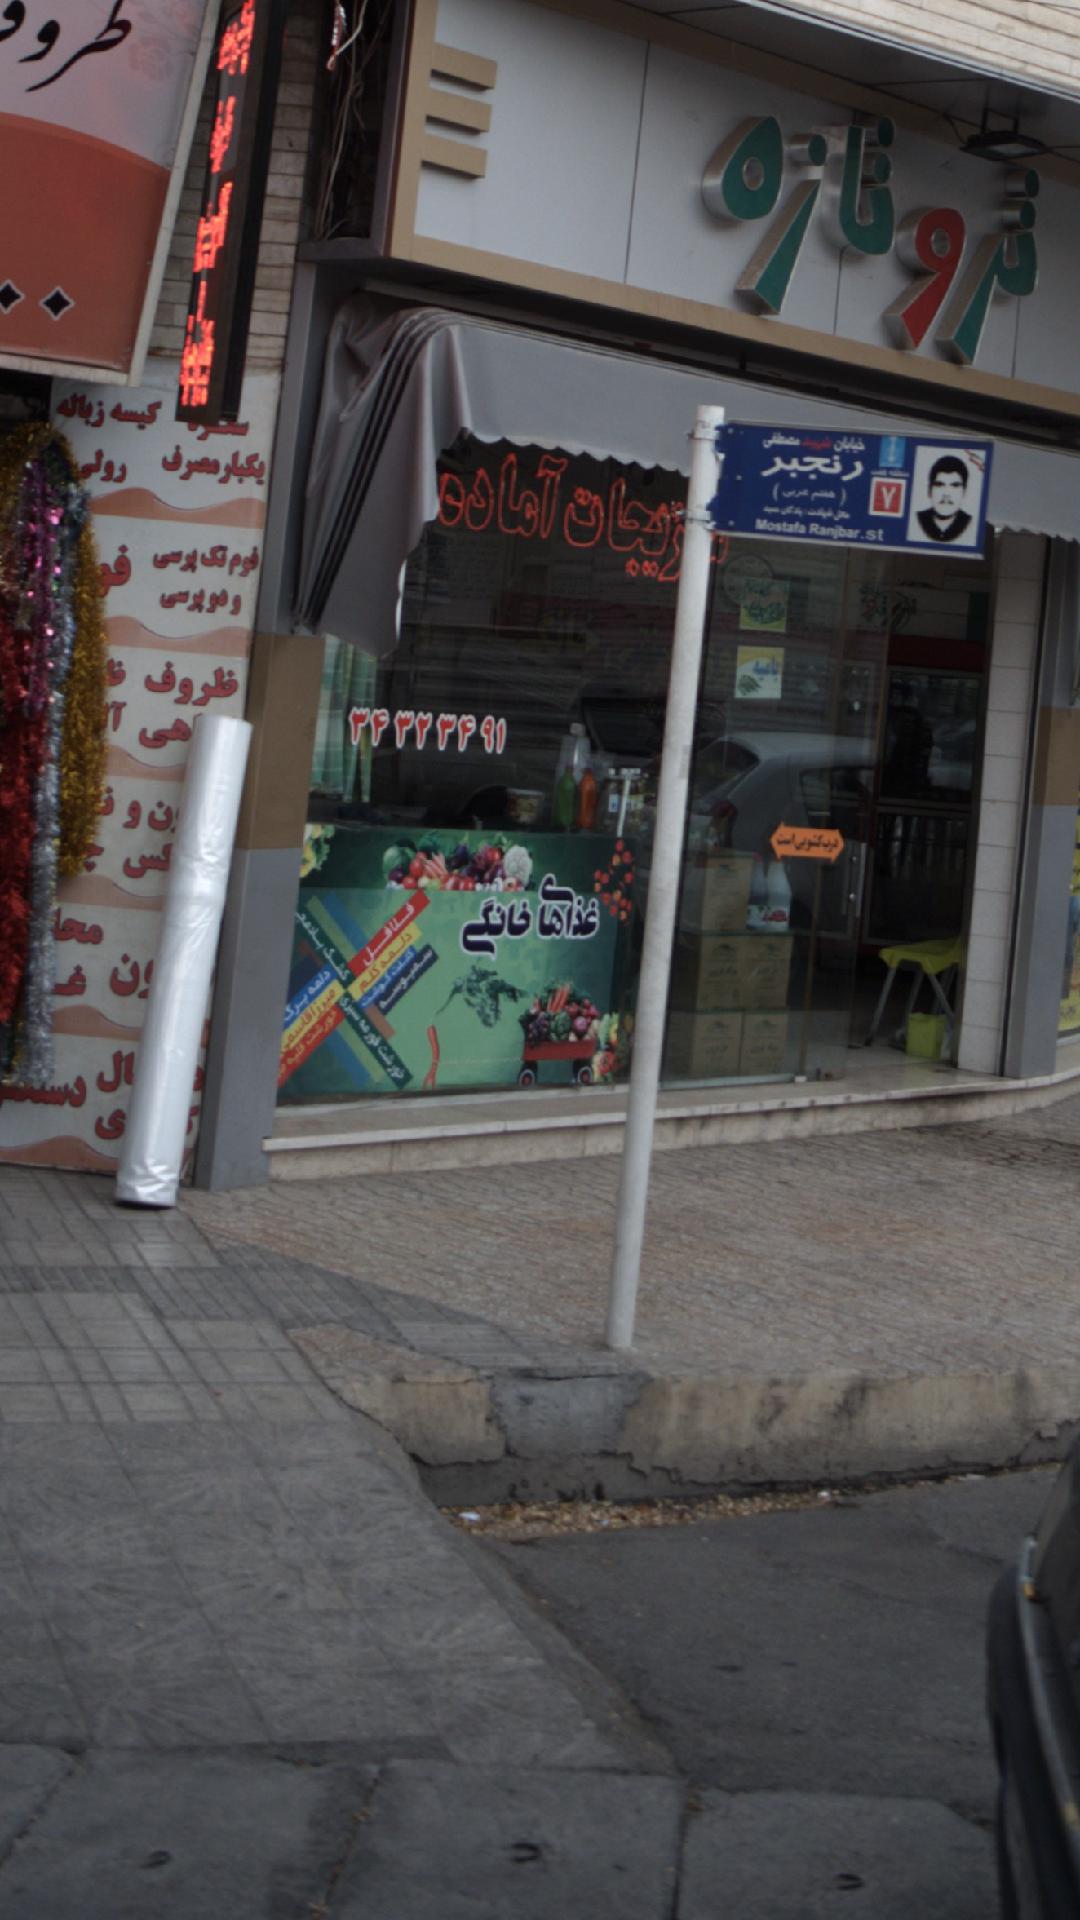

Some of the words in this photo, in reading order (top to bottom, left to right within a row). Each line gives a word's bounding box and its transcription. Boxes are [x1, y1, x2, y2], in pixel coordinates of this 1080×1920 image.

[712, 115, 895, 315] تازه
[57, 393, 104, 427] زباله
[110, 401, 162, 430] کیسه
[833, 435, 866, 454] خیابان
[162, 445, 220, 481] مصرف
[218, 451, 265, 484] یکبار
[760, 453, 865, 481] رنجبر
[881, 486, 898, 511] ۷
[755, 518, 806, 534] Mostafa
[228, 546, 259, 577] فوم
[144, 661, 239, 706] ظروف
[460, 896, 532, 960] خانگی
